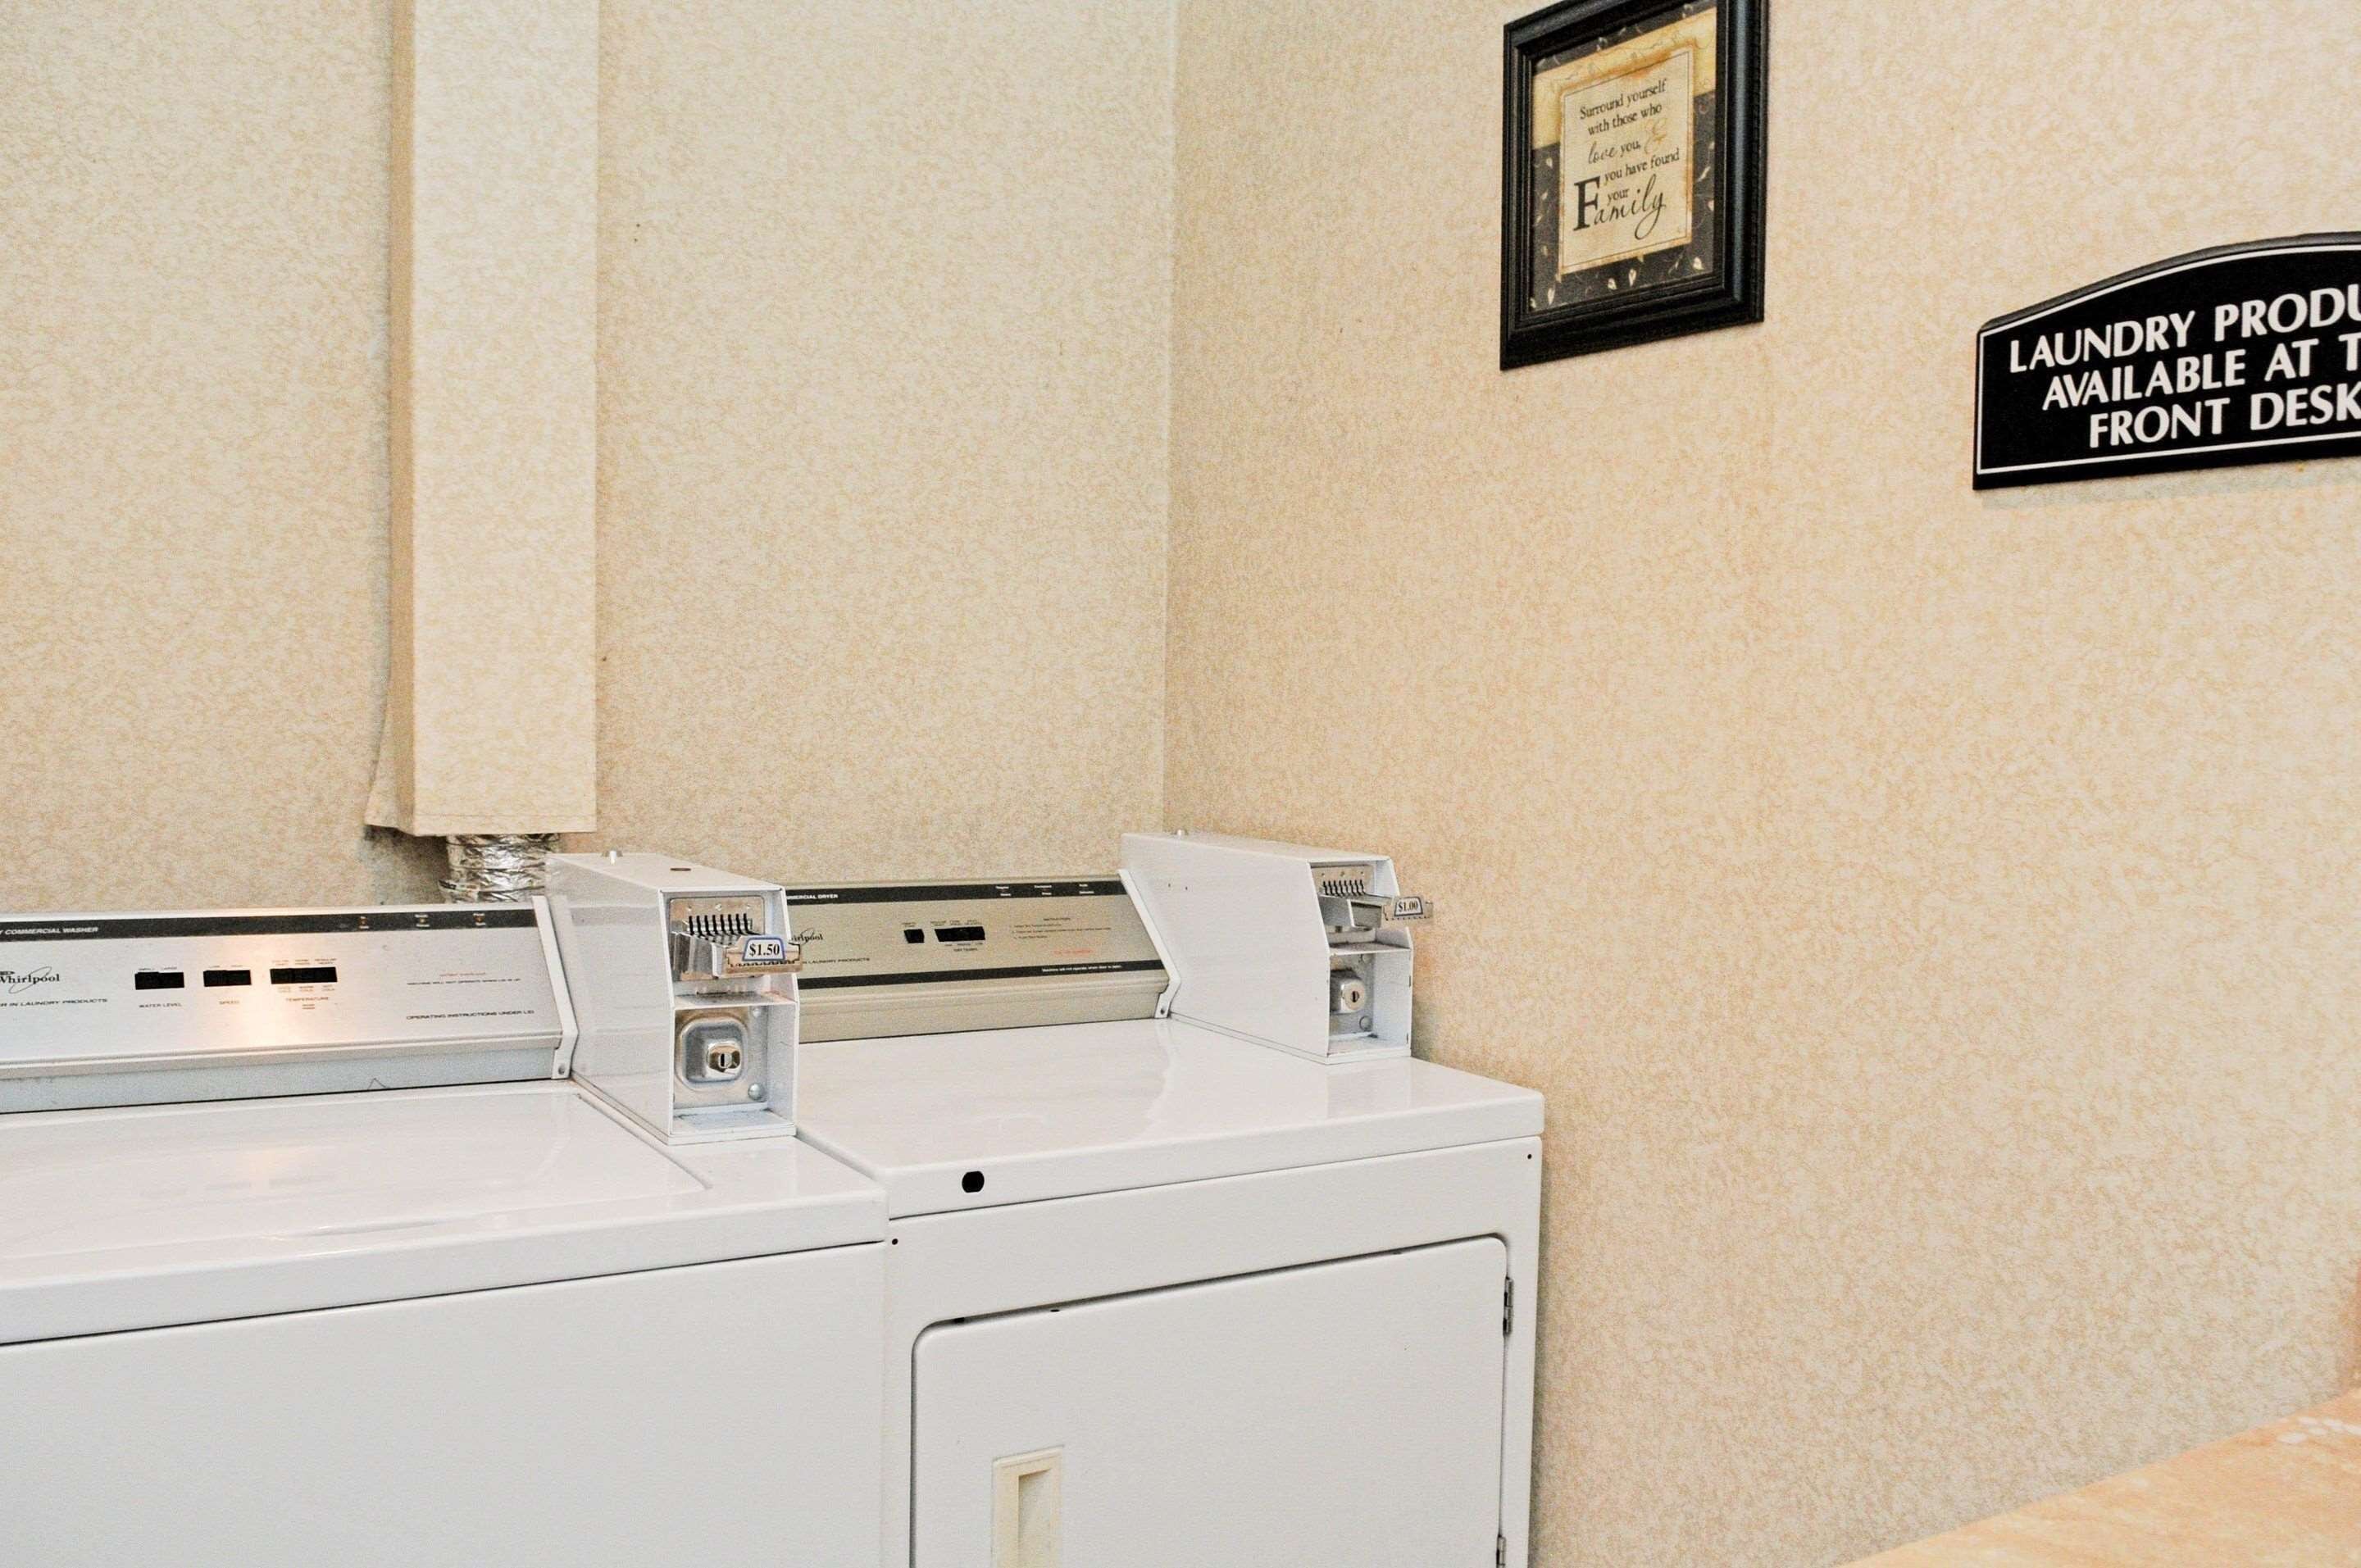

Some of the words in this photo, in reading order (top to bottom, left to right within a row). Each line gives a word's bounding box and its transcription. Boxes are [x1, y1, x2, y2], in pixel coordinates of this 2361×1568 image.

[1581, 94, 1624, 119] Surround
[1626, 79, 1666, 107] yourself
[1587, 120, 1610, 136] with
[1613, 111, 1638, 128] those
[1640, 102, 1663, 119] who
[1588, 142, 1617, 164] love
[1604, 170, 1622, 186] you
[1624, 161, 1648, 177] have
[1651, 148, 1680, 169] found
[1573, 174, 1667, 240] Family
[1606, 188, 1630, 206] your
[2009, 310, 2196, 374] LAUNDRY
[2042, 348, 2247, 411] AVAILABLE
[2264, 338, 2319, 383] AT
[2089, 397, 2231, 448] FRONT
[2250, 380, 2361, 431] DESK
[1398, 901, 1418, 912] $1.00
[748, 943, 780, 957] $1.50
